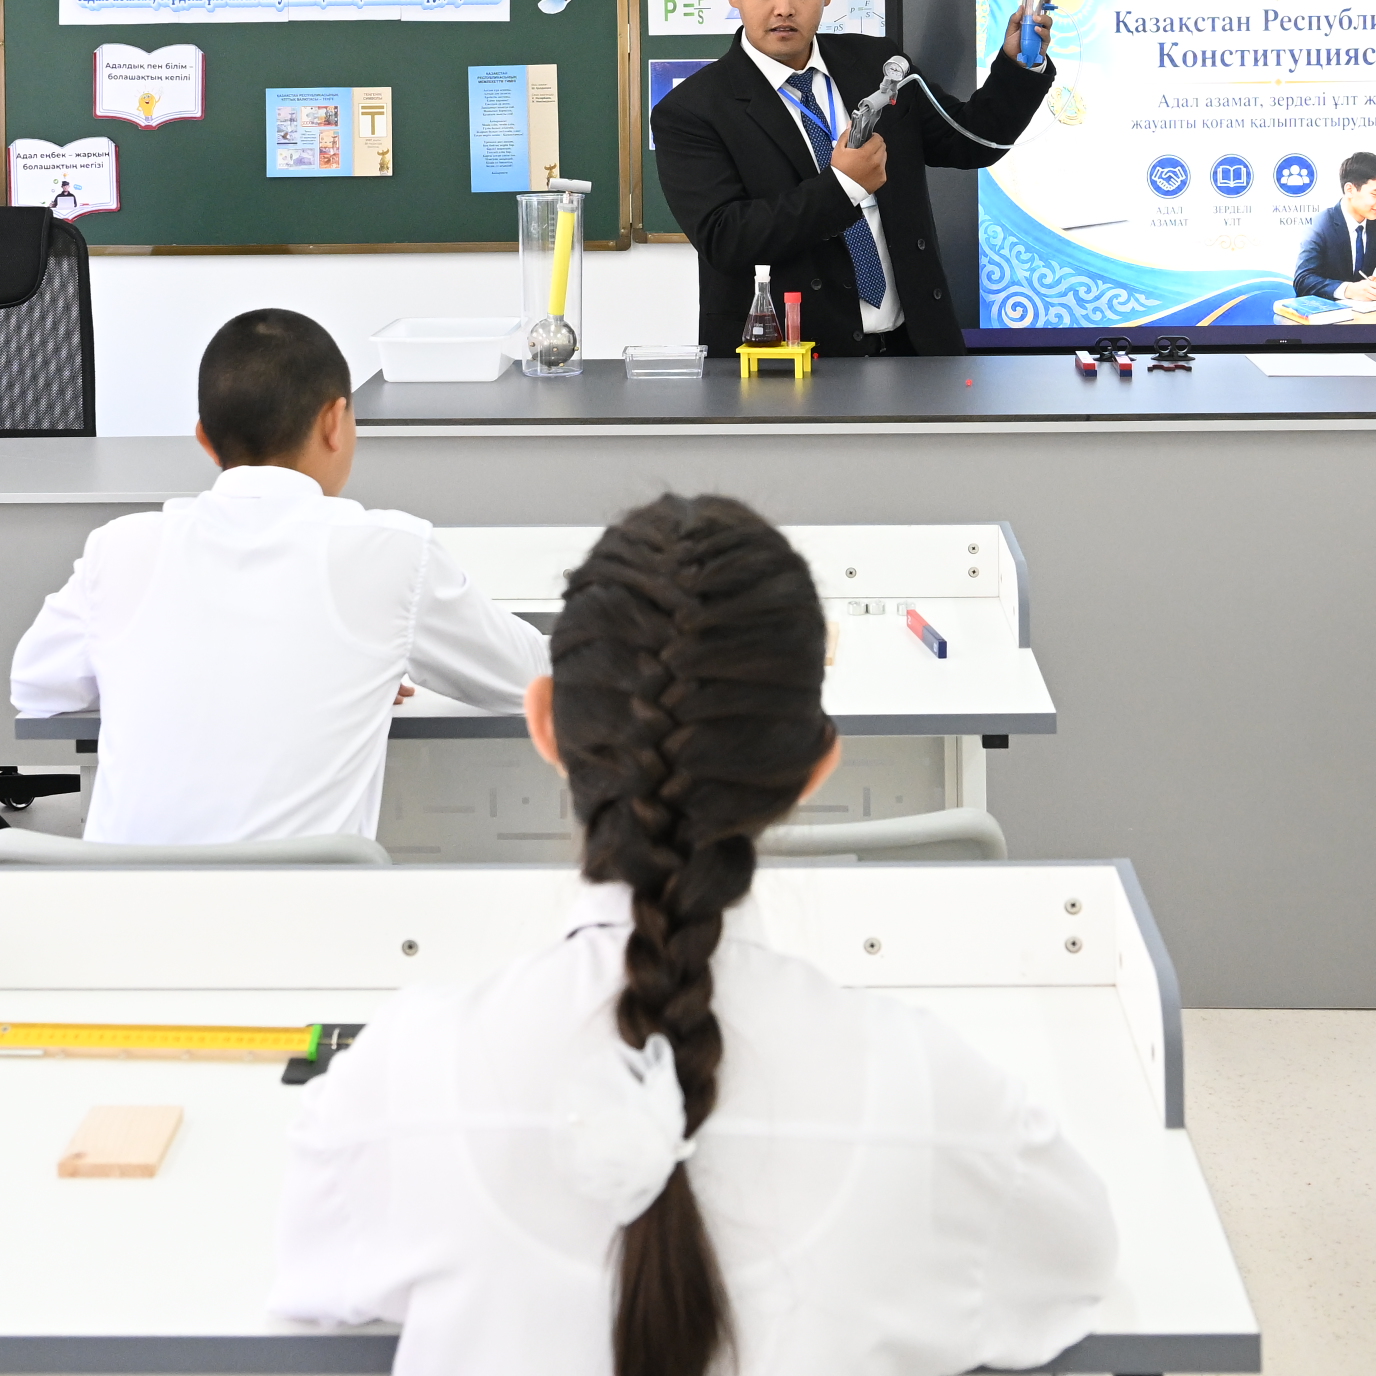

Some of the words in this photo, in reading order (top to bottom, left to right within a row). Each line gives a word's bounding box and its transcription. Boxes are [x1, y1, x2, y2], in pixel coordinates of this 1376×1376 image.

[697, 9, 704, 25] S
[1114, 10, 1252, 36] Қазақстан
[105, 62, 145, 70] Адалдық
[165, 62, 187, 70] білім
[107, 73, 163, 82] болашақтың
[165, 73, 191, 81] кепілі
[1157, 93, 1199, 110] Адал
[1205, 95, 1264, 110] азамат,
[1268, 91, 1326, 111] зерделі
[1331, 94, 1358, 110] ұлт
[1131, 117, 1197, 133] жауапты
[1201, 116, 1246, 131] қоғам
[16, 152, 38, 160] Адал
[40, 151, 67, 159] еңбек
[74, 151, 110, 159] жарқын
[79, 161, 104, 169] негізі
[1155, 205, 1184, 216] АДАЛ
[1212, 204, 1253, 216] ЗЕРДЕЛІ
[1272, 203, 1321, 214] ЖАУАПТЫ
[1149, 217, 1189, 228] АЗАМАТ
